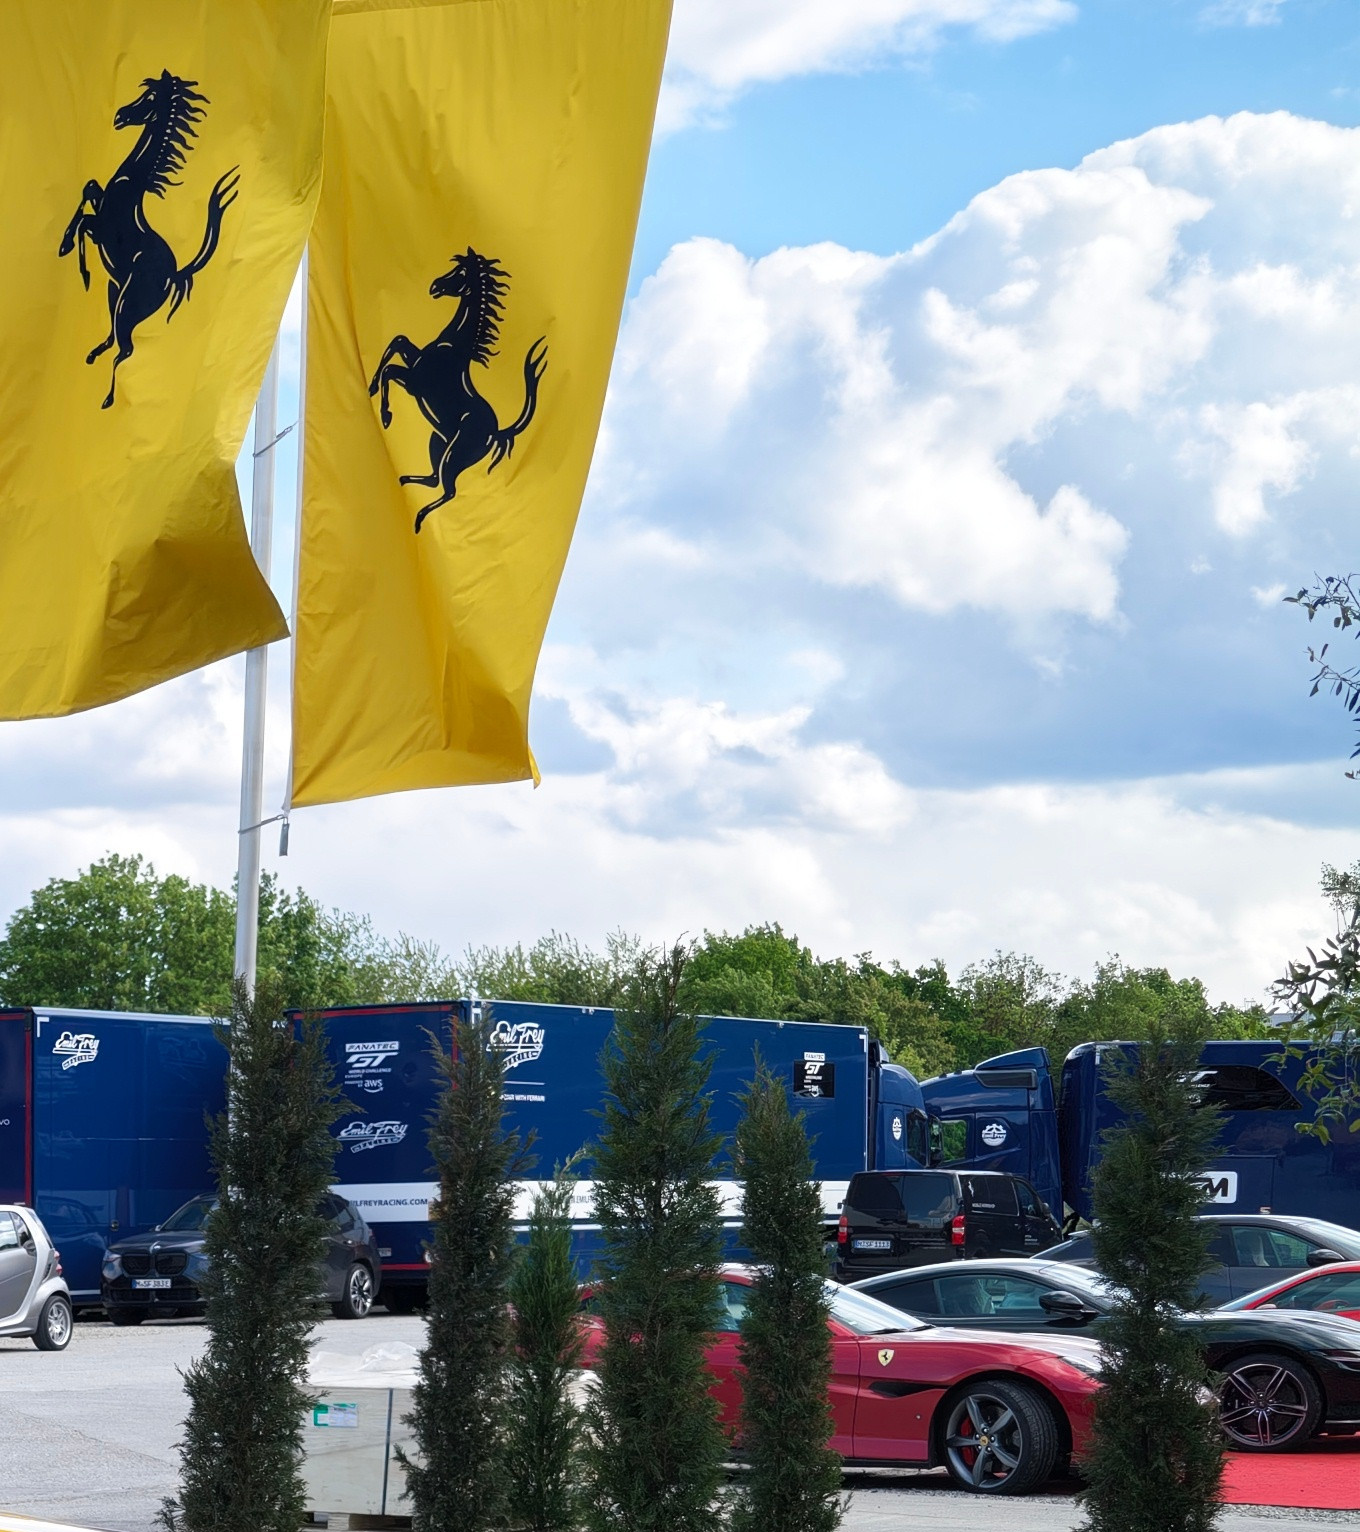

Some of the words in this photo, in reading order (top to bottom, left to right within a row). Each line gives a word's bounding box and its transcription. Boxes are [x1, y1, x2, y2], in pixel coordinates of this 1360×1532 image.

[55, 1031, 78, 1048] Emil
[78, 1033, 101, 1058] Frey
[347, 1042, 397, 1051] FANATEC
[518, 1022, 546, 1053] Frey
[363, 1079, 383, 1088] aws
[340, 1121, 373, 1137] Emil
[373, 1120, 409, 1140] Frey
